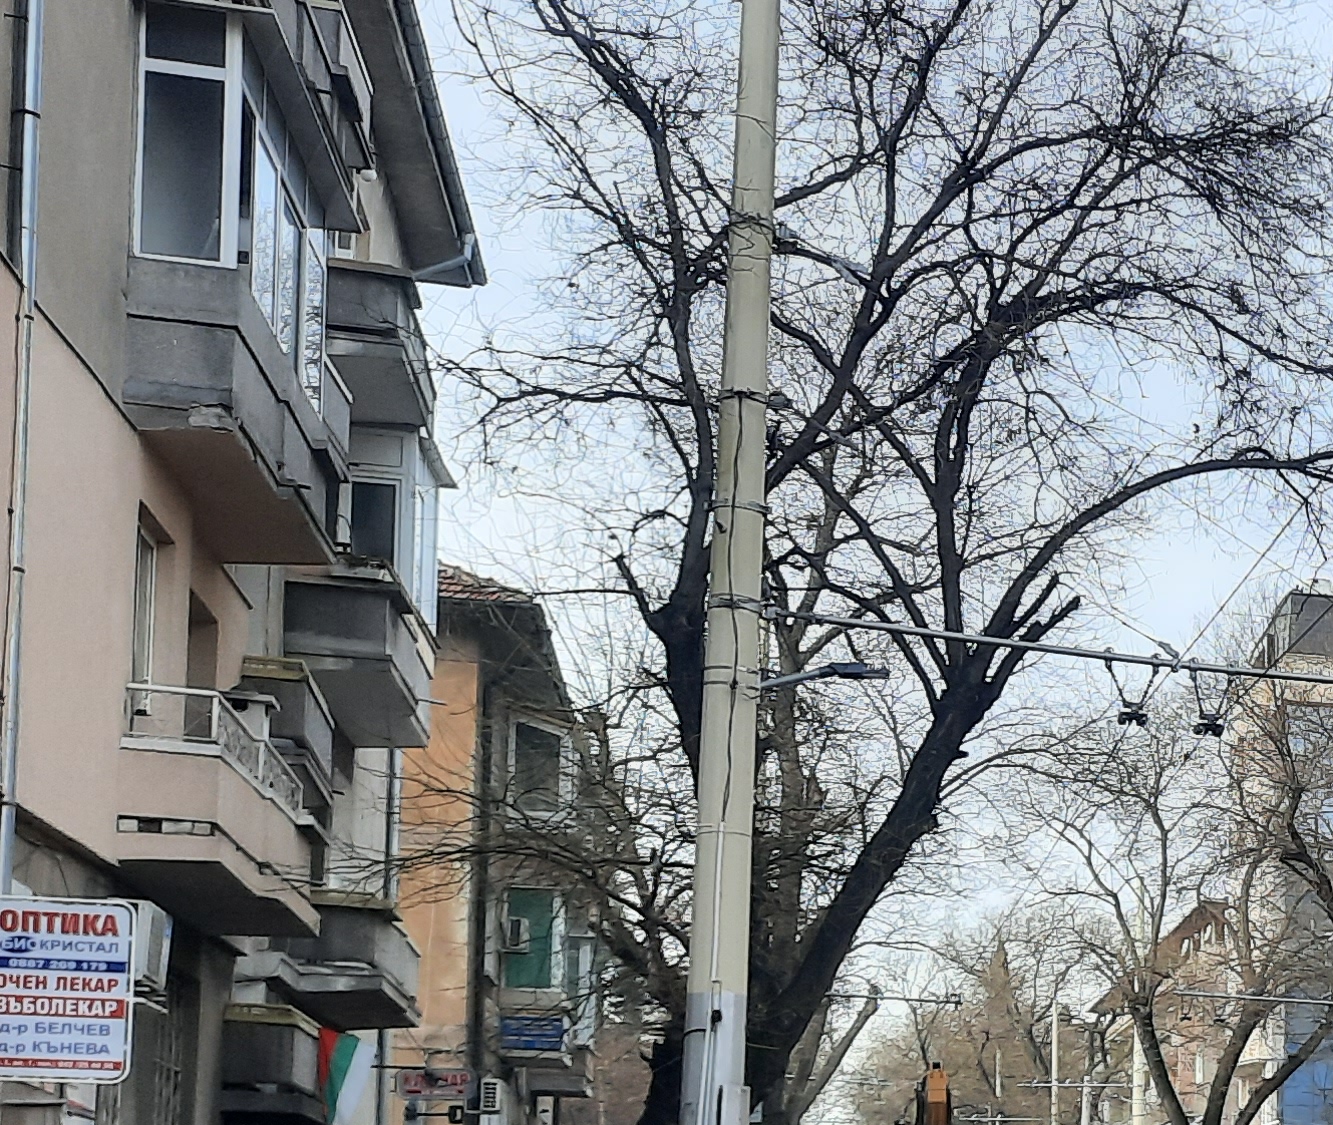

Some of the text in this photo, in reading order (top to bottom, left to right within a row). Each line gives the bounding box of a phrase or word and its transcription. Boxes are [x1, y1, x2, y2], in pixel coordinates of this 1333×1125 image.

[0, 909, 120, 938] ОПТИКА
[54, 975, 119, 993] ЛЕКАР
[34, 1021, 111, 1037] БЕЛЧЕВ
[32, 1040, 110, 1055] КЪНЕВА
